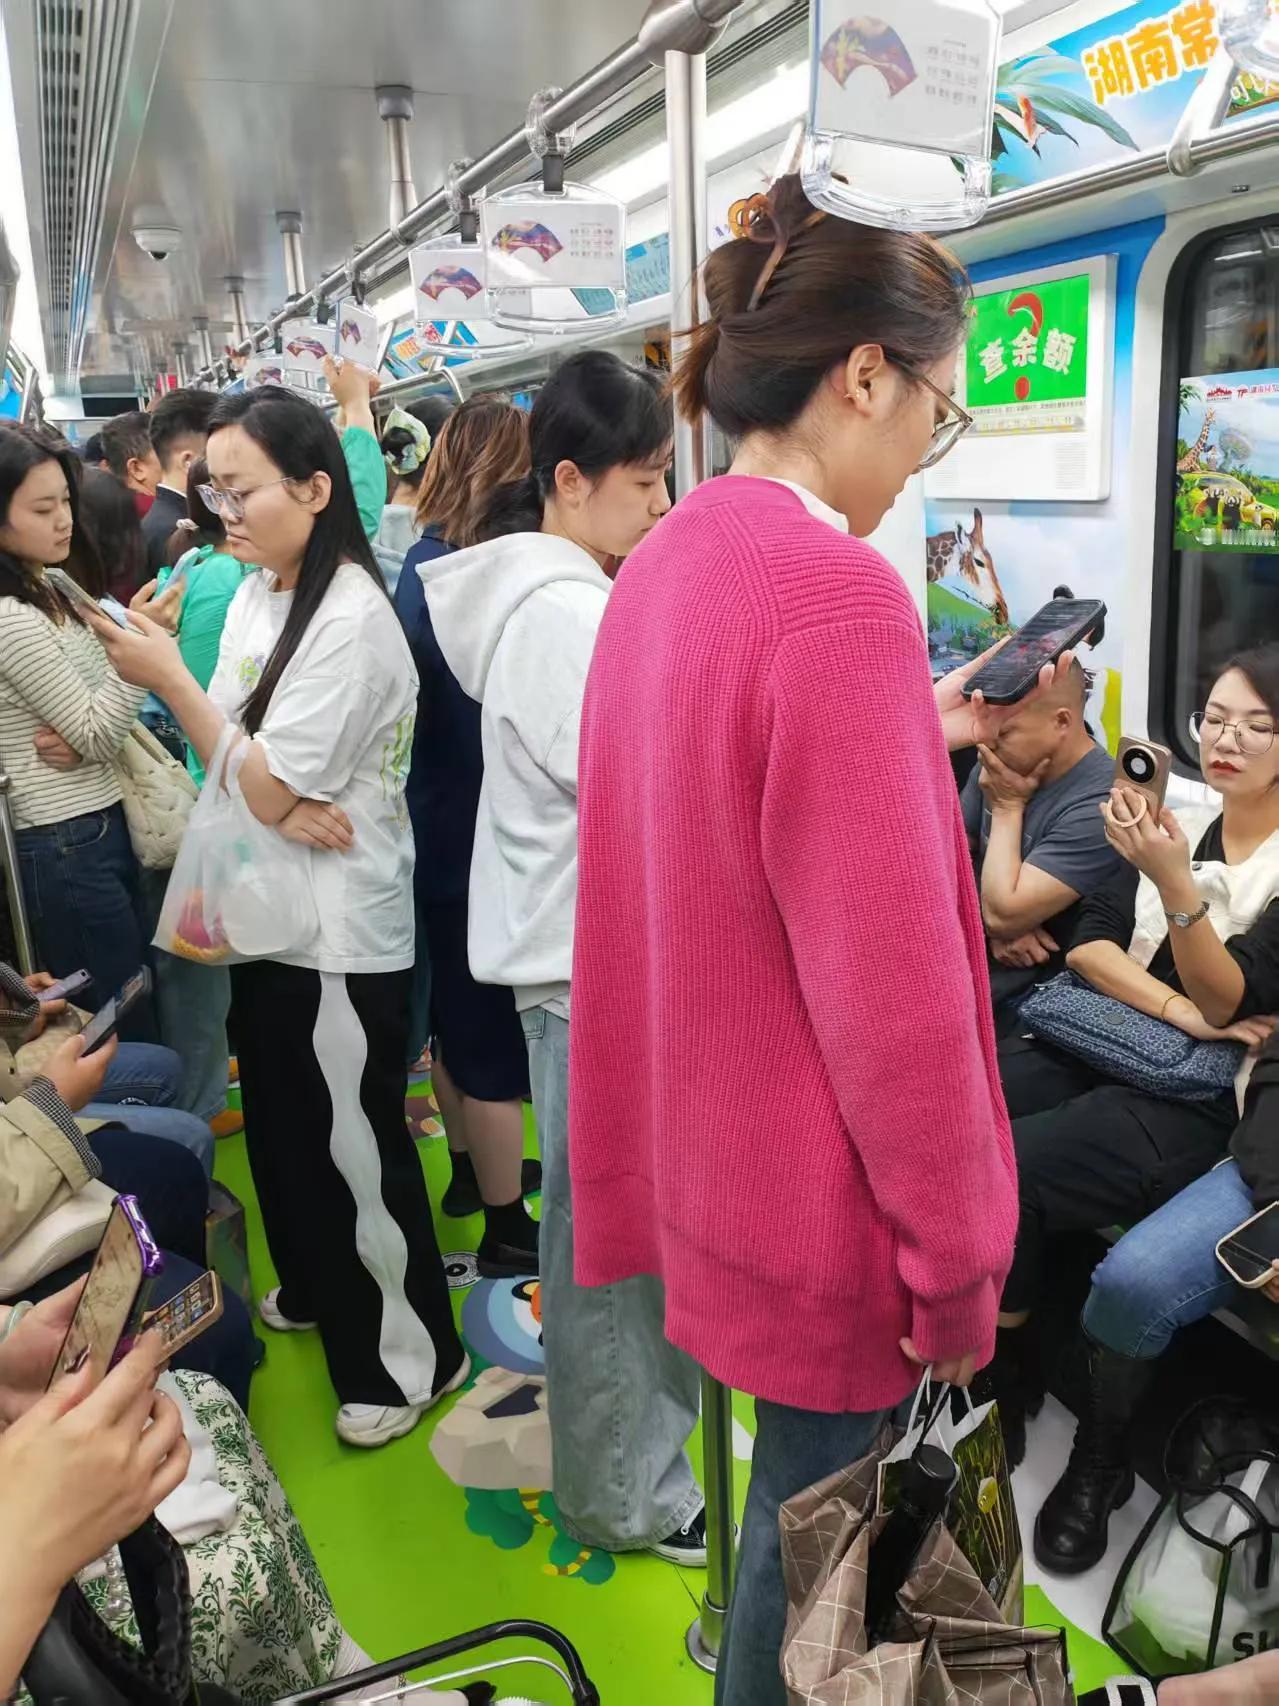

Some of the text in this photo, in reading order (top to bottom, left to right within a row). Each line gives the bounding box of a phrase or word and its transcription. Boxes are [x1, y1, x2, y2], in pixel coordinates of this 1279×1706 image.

[1084, 0, 1219, 103] 湖南常
[977, 327, 1077, 385] 查余额
